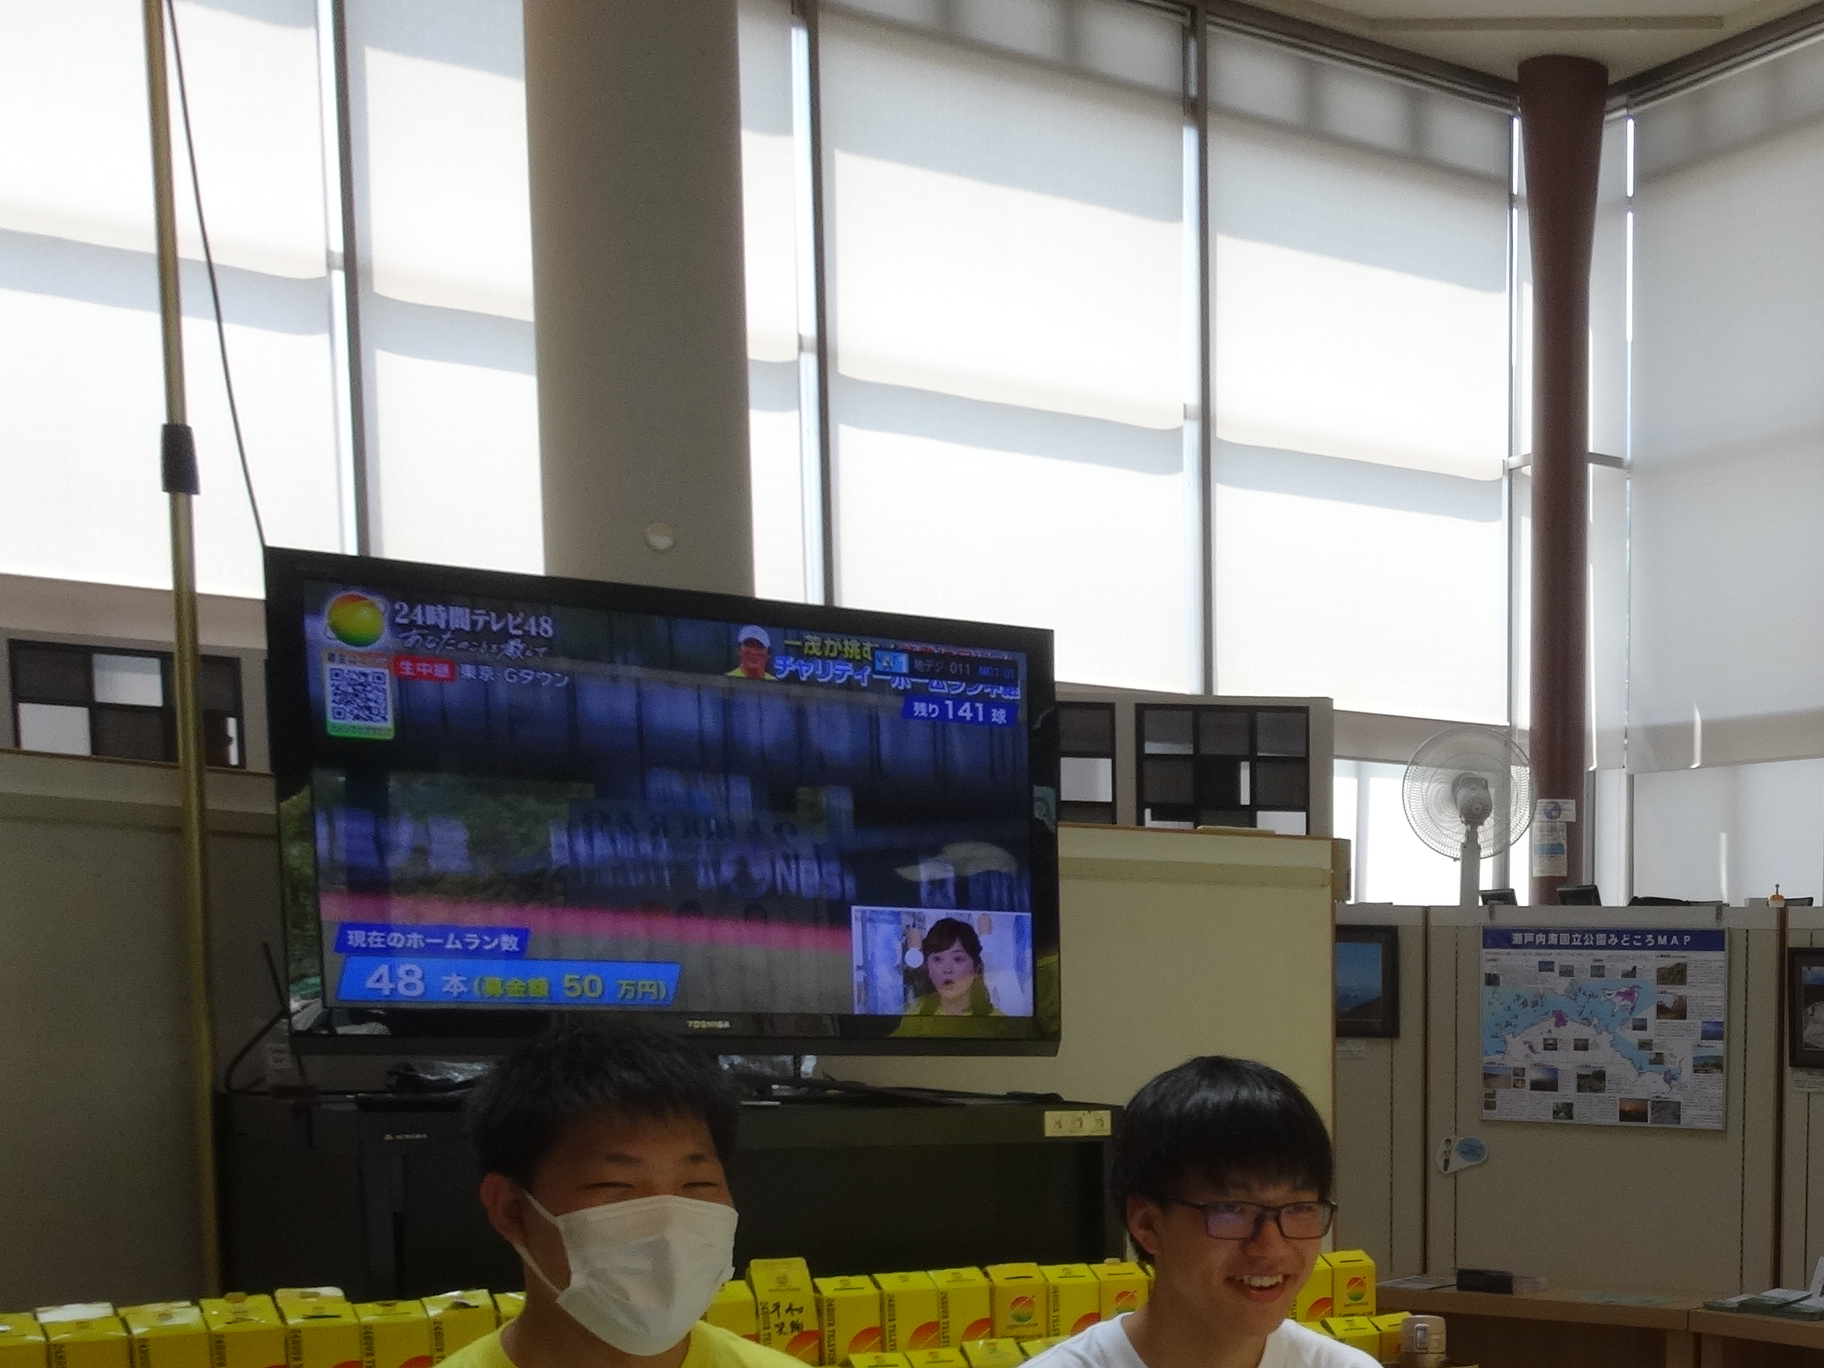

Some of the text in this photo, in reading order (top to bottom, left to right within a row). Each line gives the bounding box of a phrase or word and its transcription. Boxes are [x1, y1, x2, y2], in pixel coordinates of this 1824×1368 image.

[347, 930, 520, 953] 現在のホームラン数
